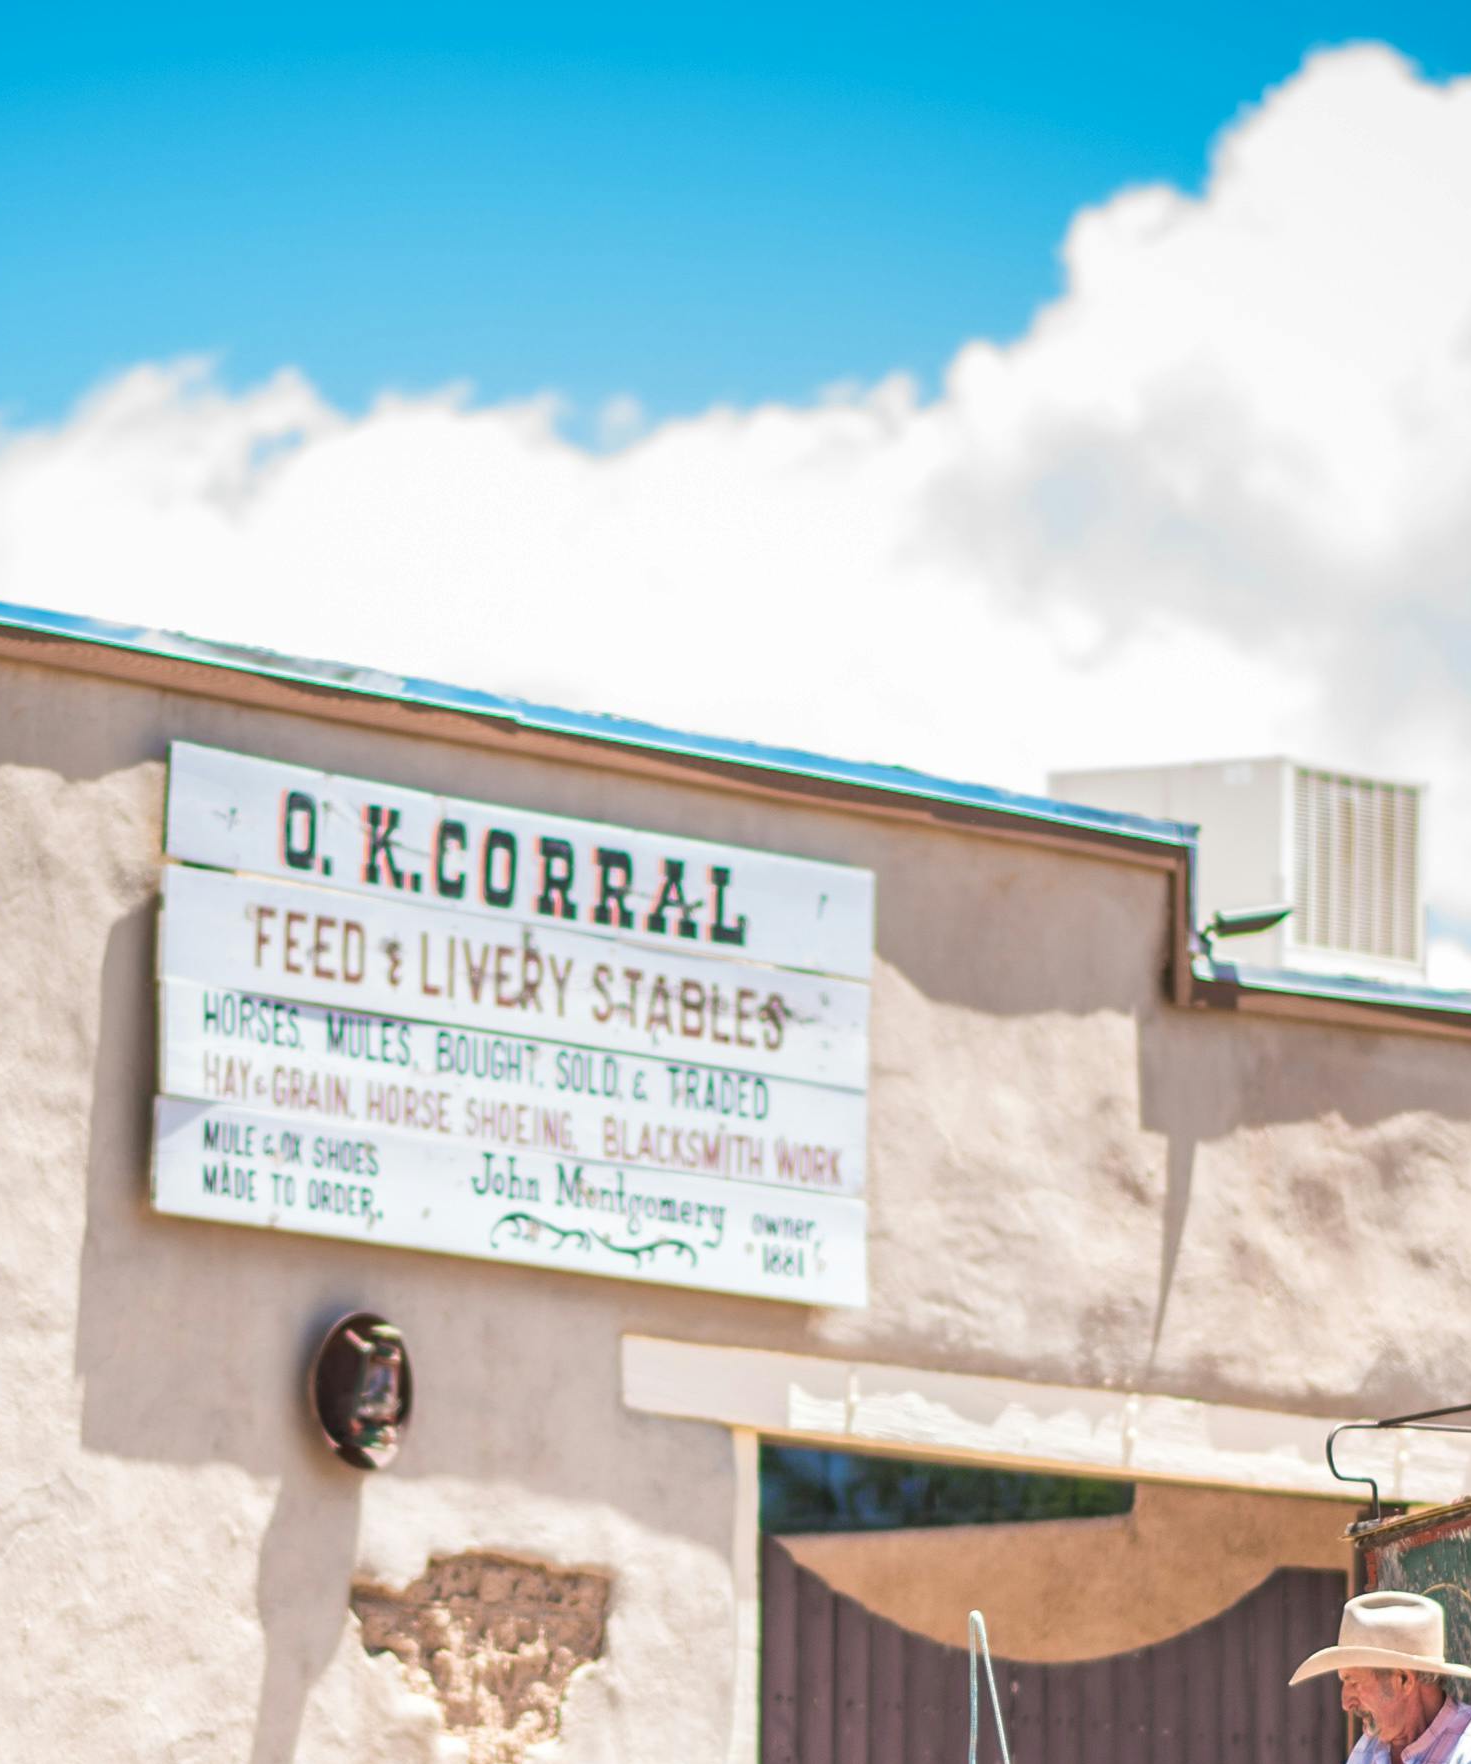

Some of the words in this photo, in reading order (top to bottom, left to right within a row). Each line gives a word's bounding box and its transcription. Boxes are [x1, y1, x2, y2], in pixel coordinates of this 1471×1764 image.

[250, 904, 368, 985] FEED
[419, 930, 574, 1017] LIVERY
[592, 962, 792, 1054] STABLES
[201, 1051, 253, 1101] HAY
[366, 1080, 452, 1134] HORSE
[602, 1113, 764, 1177] BLACKSMITH
[773, 1136, 844, 1187] WORK
[666, 1066, 770, 1121] TRADED
[202, 1118, 256, 1158] MULE
[279, 1130, 302, 1165] OX
[312, 1136, 381, 1178] SHOES
[201, 1161, 258, 1202] MADE
[269, 1173, 295, 1208] TO
[471, 1151, 542, 1202] John
[554, 1162, 728, 1250] Montgomery
[761, 1244, 807, 1279] 1881
